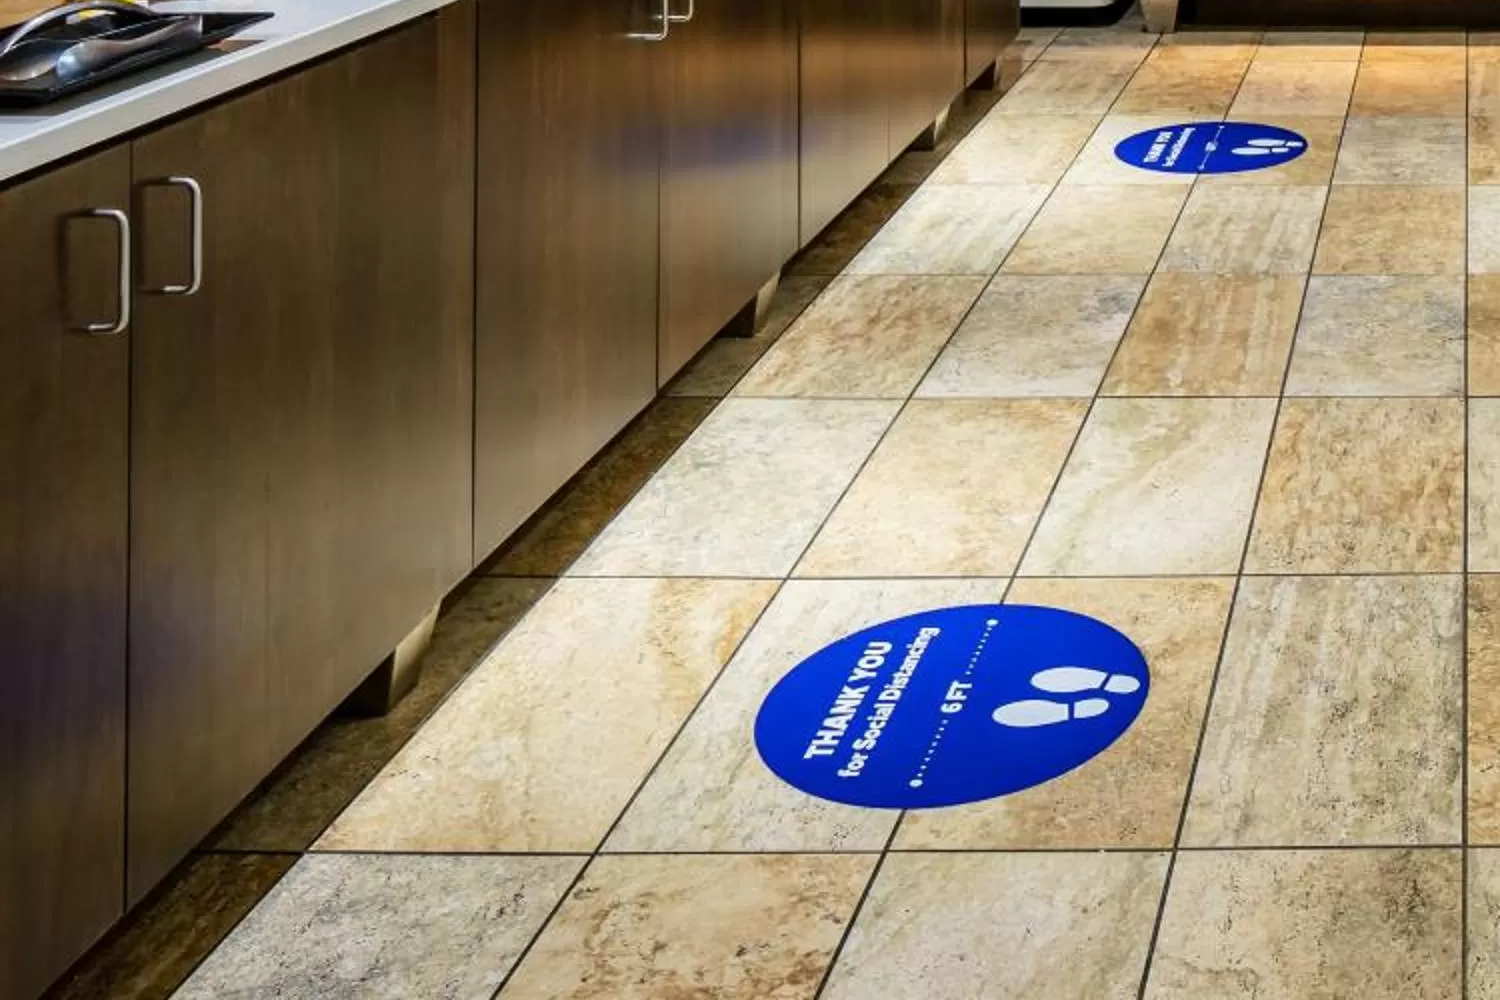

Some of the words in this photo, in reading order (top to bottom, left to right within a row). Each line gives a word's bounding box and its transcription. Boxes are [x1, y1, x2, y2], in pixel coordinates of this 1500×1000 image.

[878, 627, 941, 701] Distancing
[803, 685, 870, 759] THANK
[848, 641, 893, 682] YOU
[852, 703, 896, 751] Social
[837, 752, 869, 777] for
